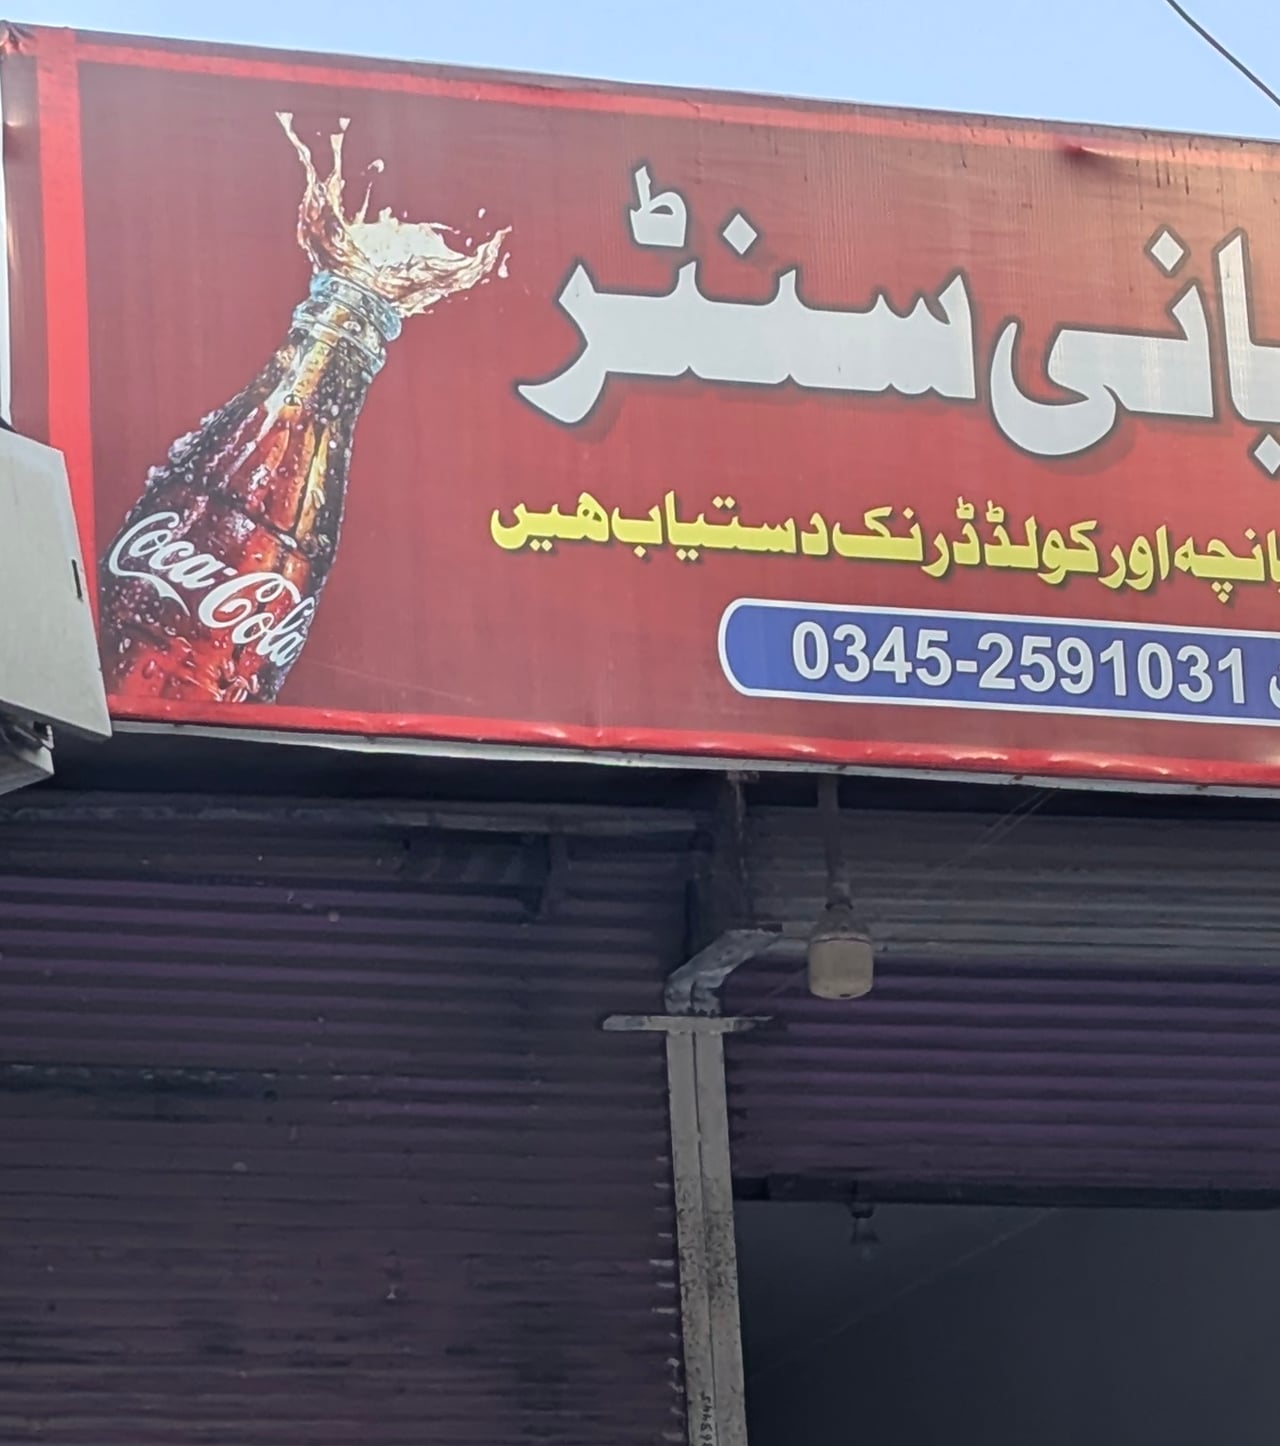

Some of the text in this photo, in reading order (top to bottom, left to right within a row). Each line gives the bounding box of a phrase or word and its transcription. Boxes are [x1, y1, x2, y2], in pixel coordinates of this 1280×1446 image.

[518, 165, 976, 424] سنٹر
[611, 490, 829, 561] دستیاب
[1098, 525, 1170, 590] اور
[792, 621, 1246, 705] 0345-2591031
